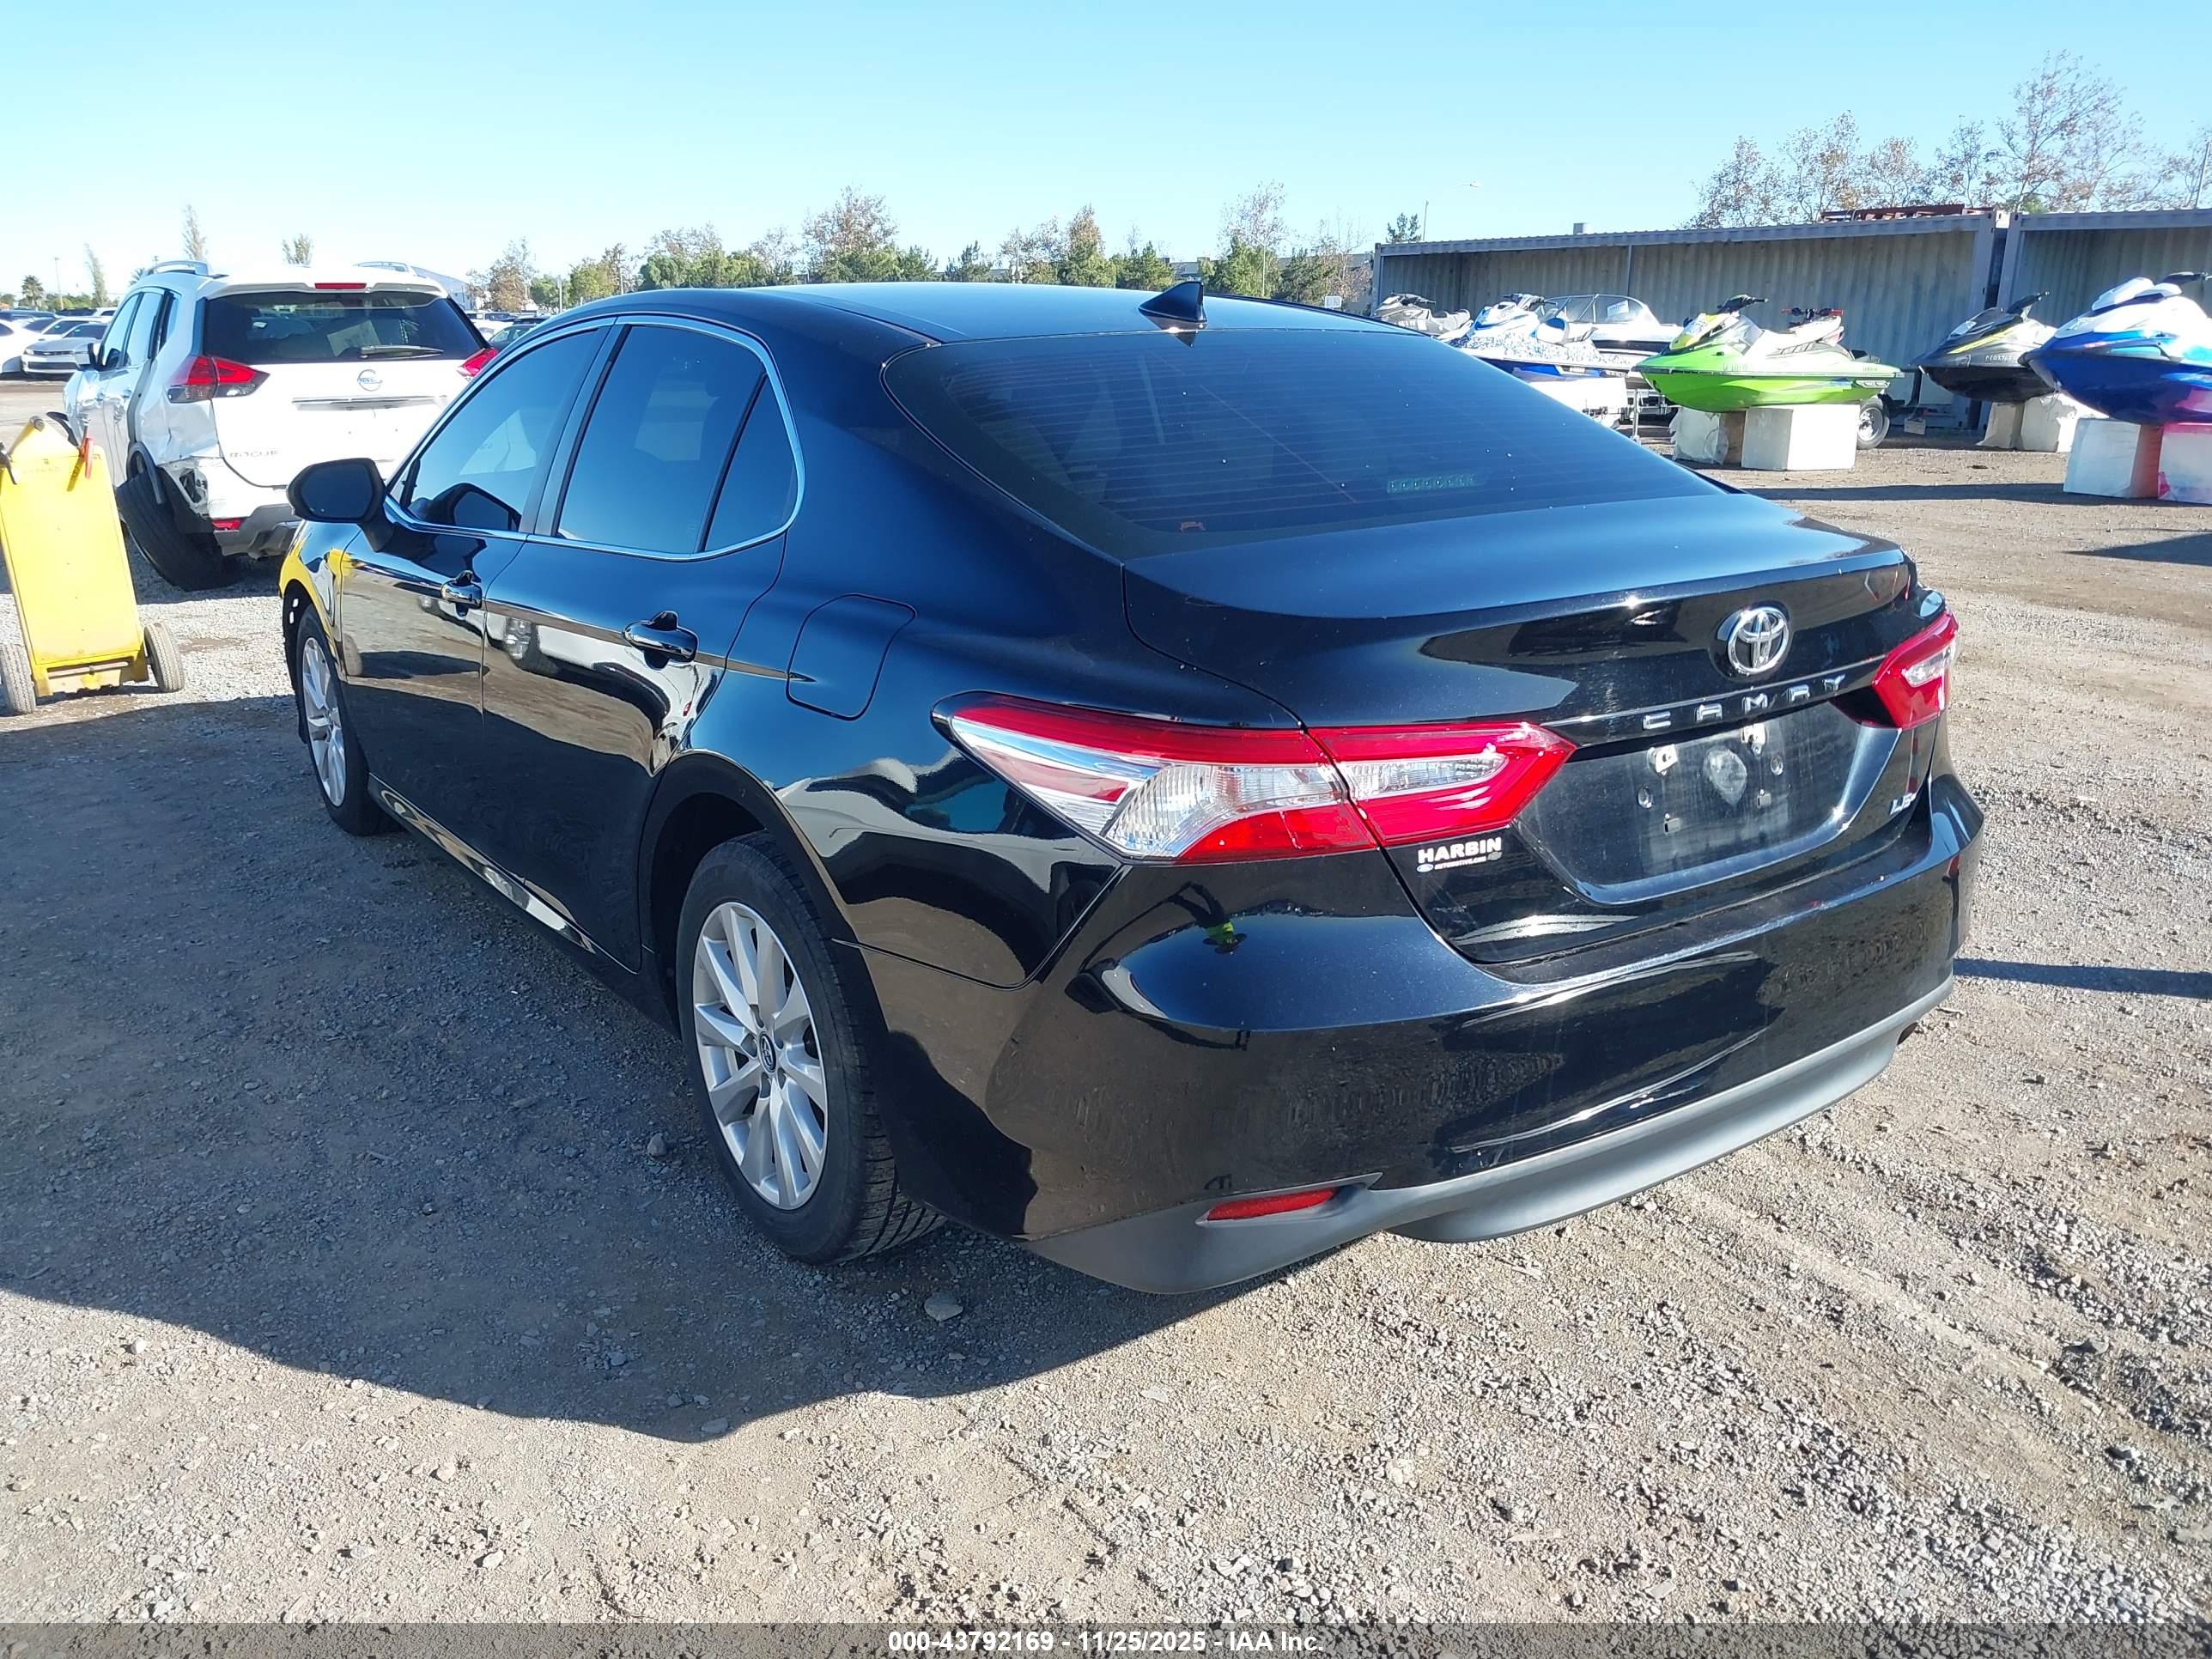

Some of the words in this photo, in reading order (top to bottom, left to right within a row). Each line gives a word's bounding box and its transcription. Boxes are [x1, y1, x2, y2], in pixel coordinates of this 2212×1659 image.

[1642, 673, 1846, 731] CAMRY
[1889, 793, 1917, 816] LE
[1418, 837, 1502, 864] HARBIN
